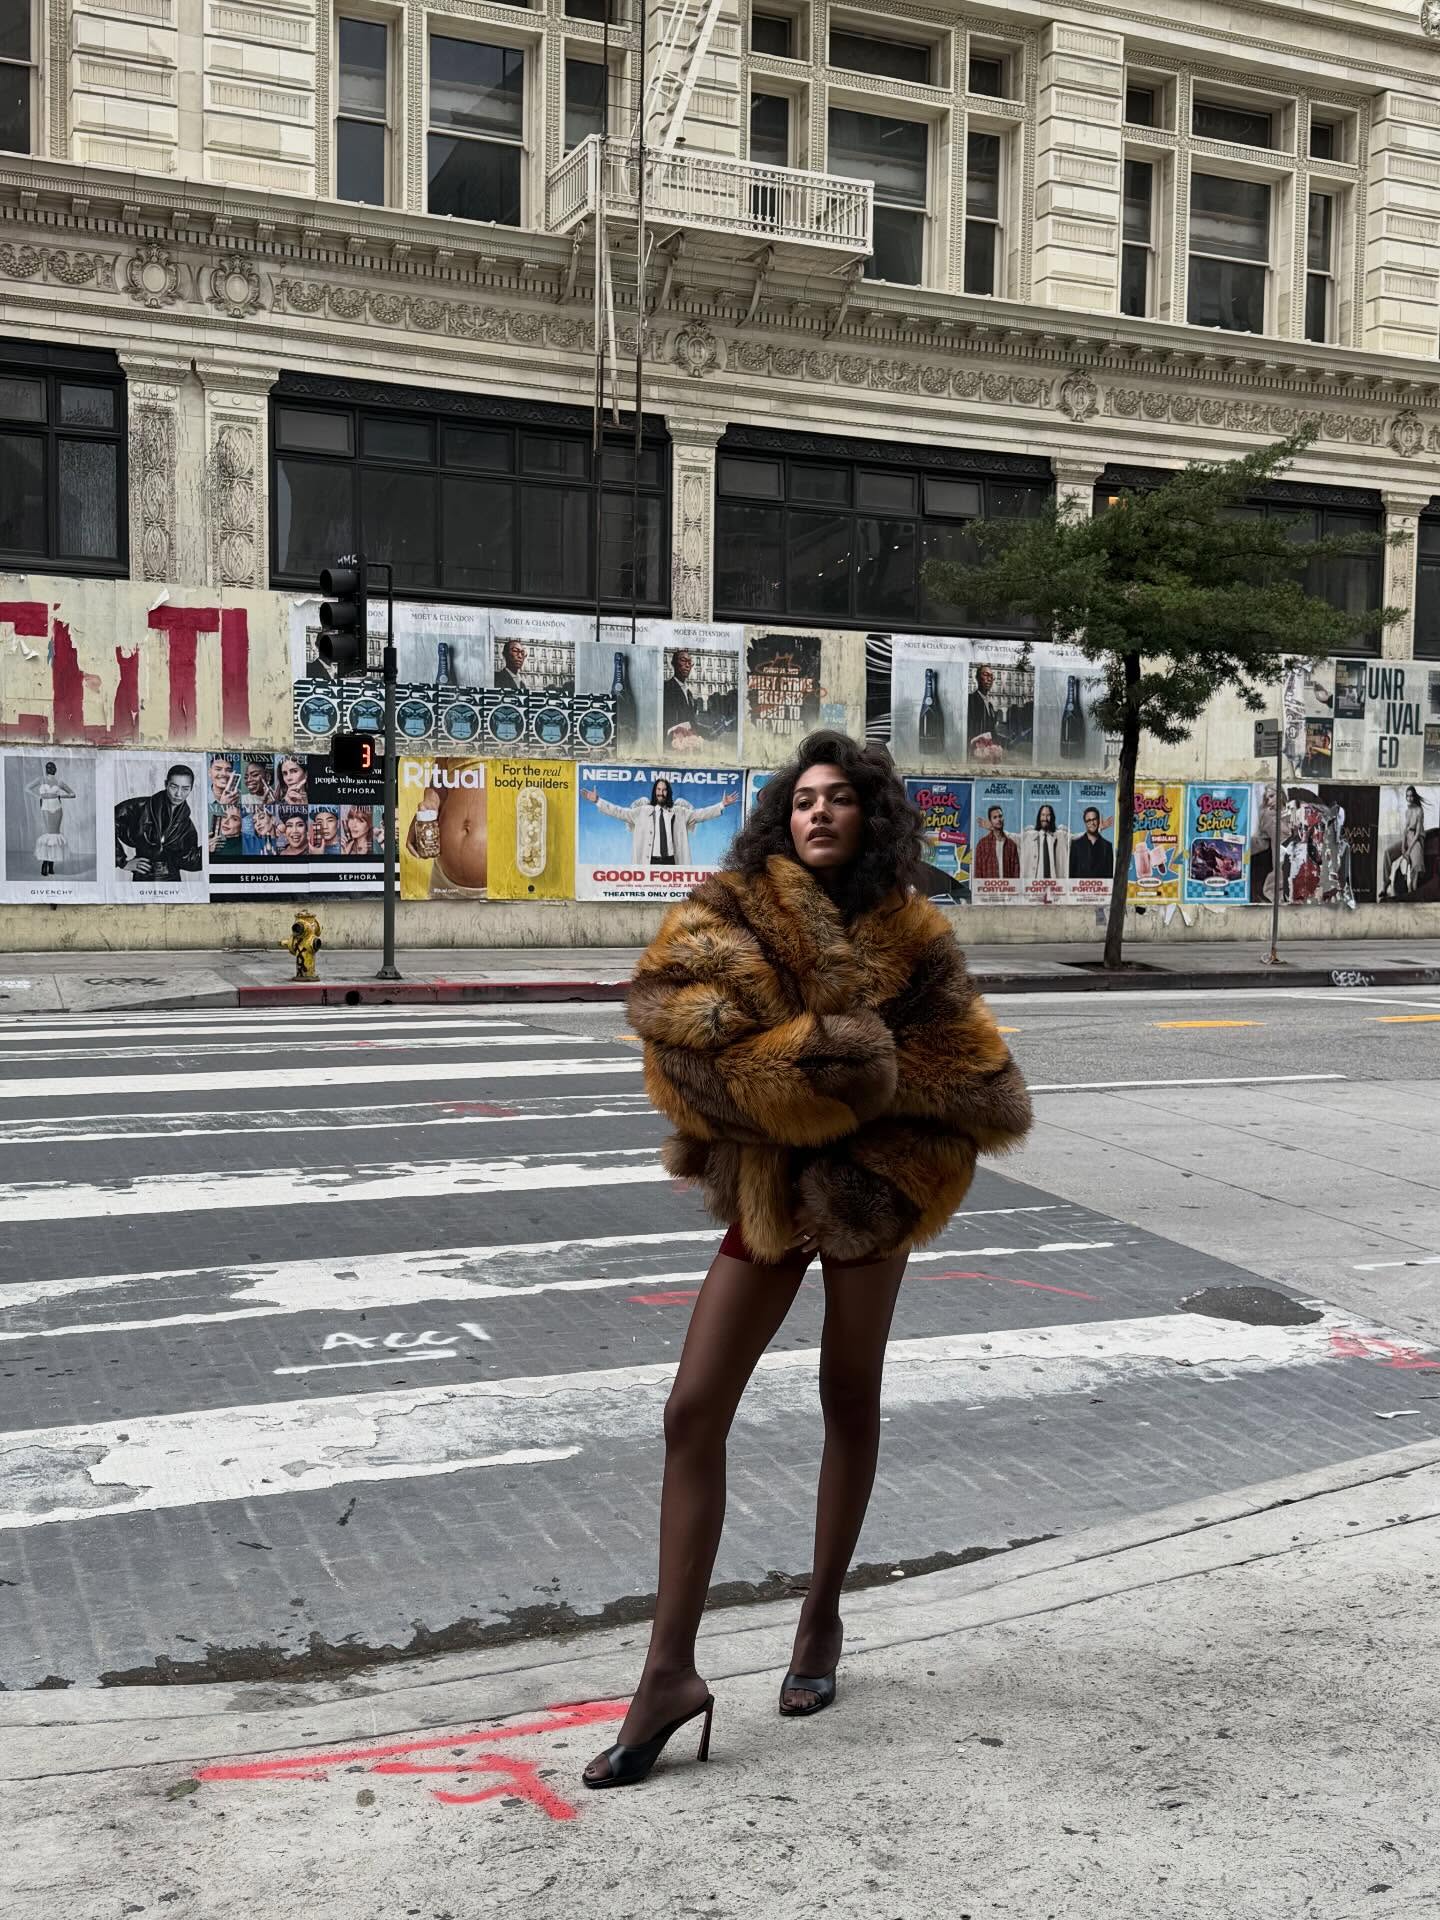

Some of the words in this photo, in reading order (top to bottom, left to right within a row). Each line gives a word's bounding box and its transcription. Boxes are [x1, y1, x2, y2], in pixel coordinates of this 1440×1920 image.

[1368, 667, 1405, 701] UNR
[758, 691, 803, 705] RELEASES
[789, 706, 801, 720] TO
[1385, 702, 1424, 736] IVAL
[362, 744, 371, 768] 3
[1378, 735, 1400, 769] ED
[314, 775, 338, 785] people
[402, 761, 486, 789] Ritual
[503, 764, 520, 775] For
[523, 764, 541, 775] the
[543, 765, 562, 776] real
[582, 768, 632, 781] NEED
[634, 770, 647, 782] A
[651, 771, 740, 785] MIRACLE?
[494, 776, 522, 790] body
[525, 777, 569, 790] builders
[916, 789, 961, 810] Back
[1197, 793, 1240, 814] Back
[1196, 813, 1239, 833] School
[592, 870, 646, 883] GOOD
[650, 871, 718, 883] FORTUN
